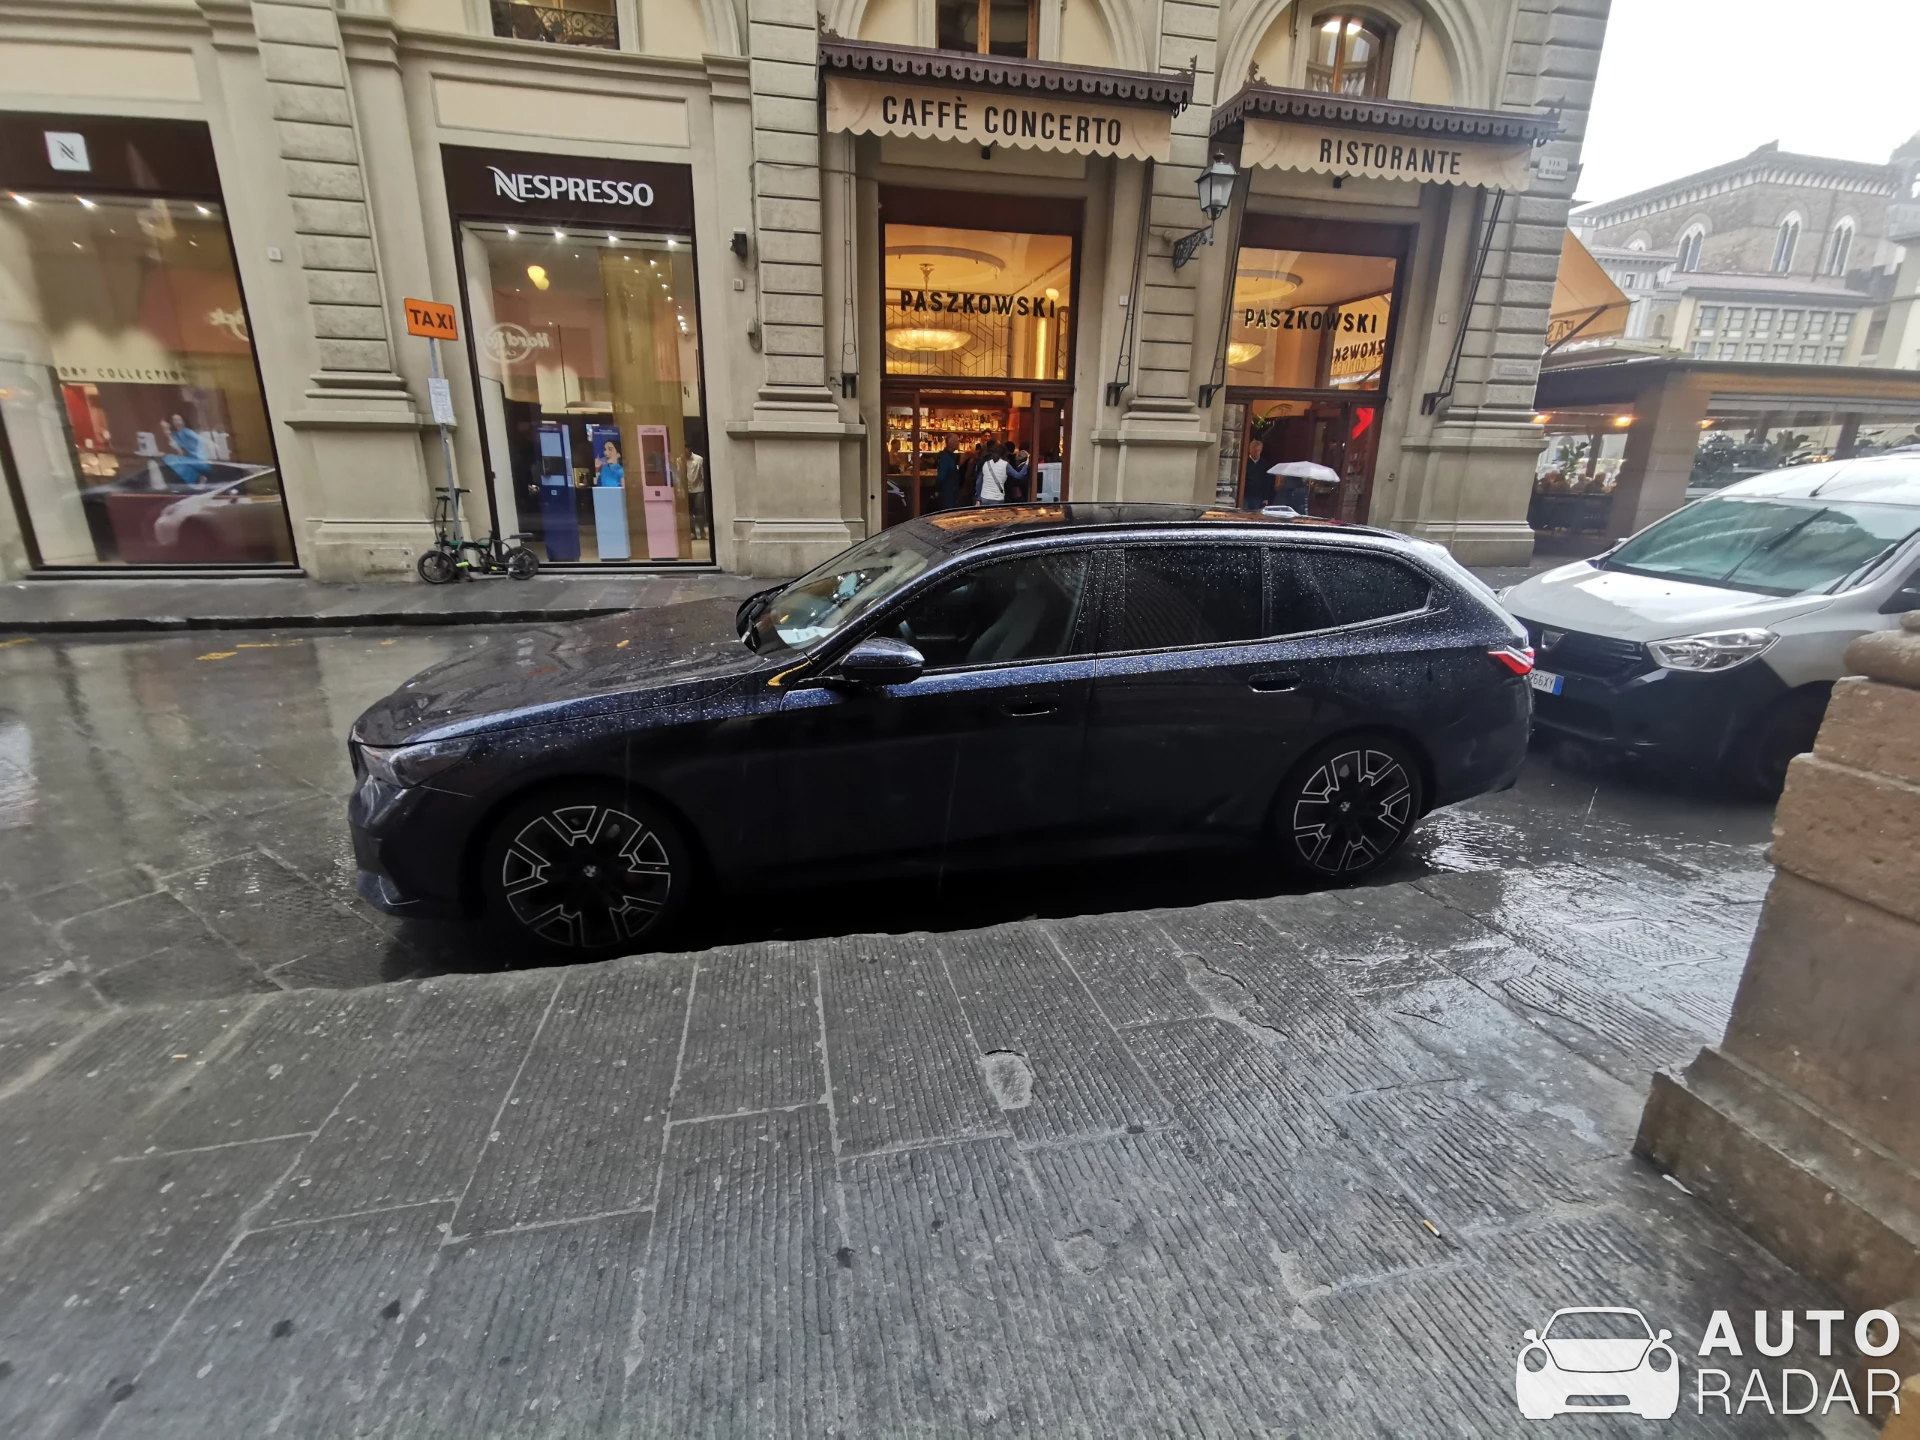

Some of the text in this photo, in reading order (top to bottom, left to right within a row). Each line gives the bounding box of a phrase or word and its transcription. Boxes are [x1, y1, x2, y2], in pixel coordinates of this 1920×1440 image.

[882, 94, 1122, 146] CAFFÈ CONCERTO
[1319, 138, 1462, 176] RISTORANTE
[486, 165, 655, 208] NESPRESSO
[409, 308, 454, 330] TAXI
[900, 290, 1055, 318] PASZKOWSKI
[1244, 308, 1378, 334] PASZKOWSKI
